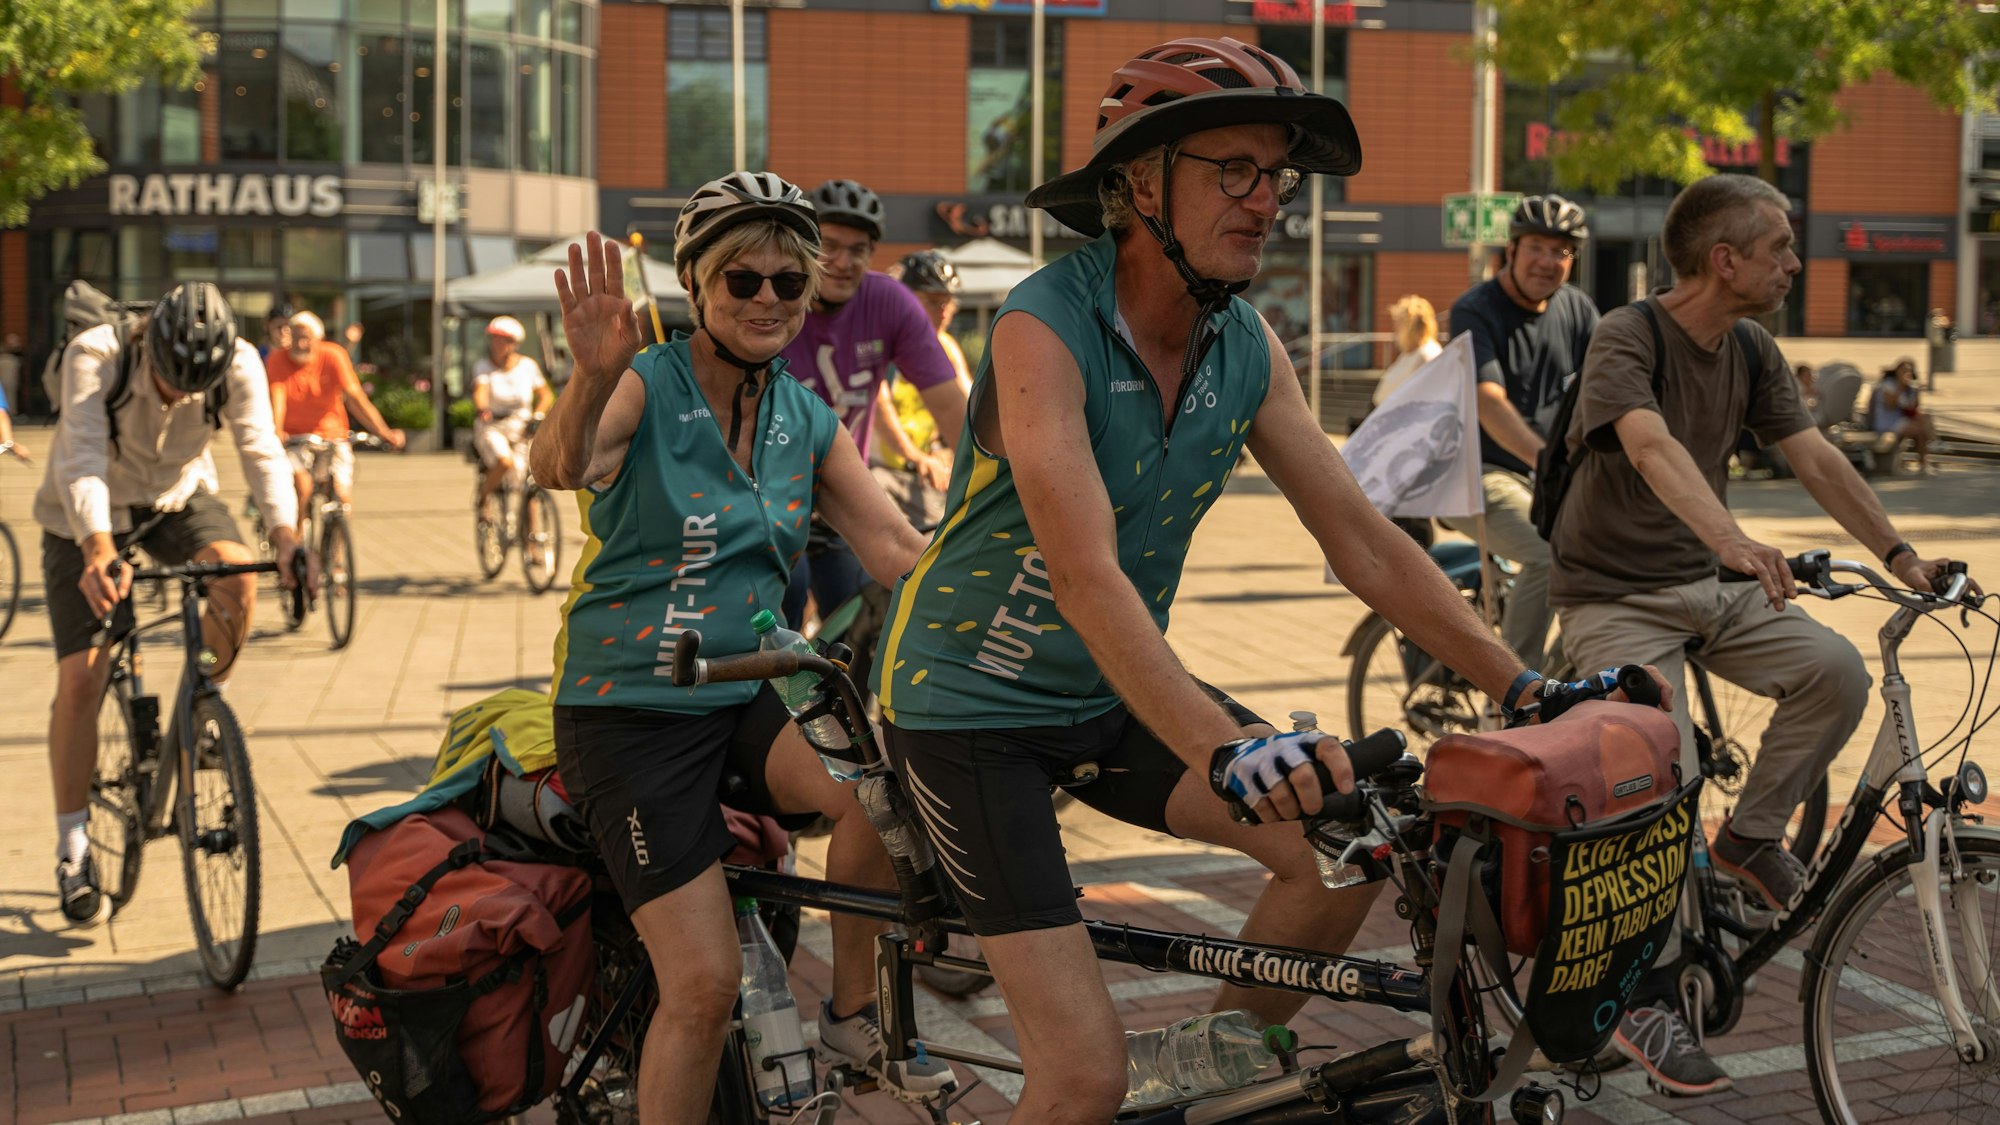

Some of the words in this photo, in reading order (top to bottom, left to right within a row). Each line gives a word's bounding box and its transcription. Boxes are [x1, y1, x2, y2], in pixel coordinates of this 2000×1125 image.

[109, 173, 343, 217] RATHAUS
[968, 548, 1056, 681] MUT-TO
[1562, 837, 1688, 927] DEPRESSION
[1556, 918, 1608, 962] KEIN
[1609, 898, 1653, 946] TABU
[1651, 880, 1679, 926] SEIN
[1188, 943, 1360, 996] mut-tour.de
[1546, 950, 1613, 995] DARF!
